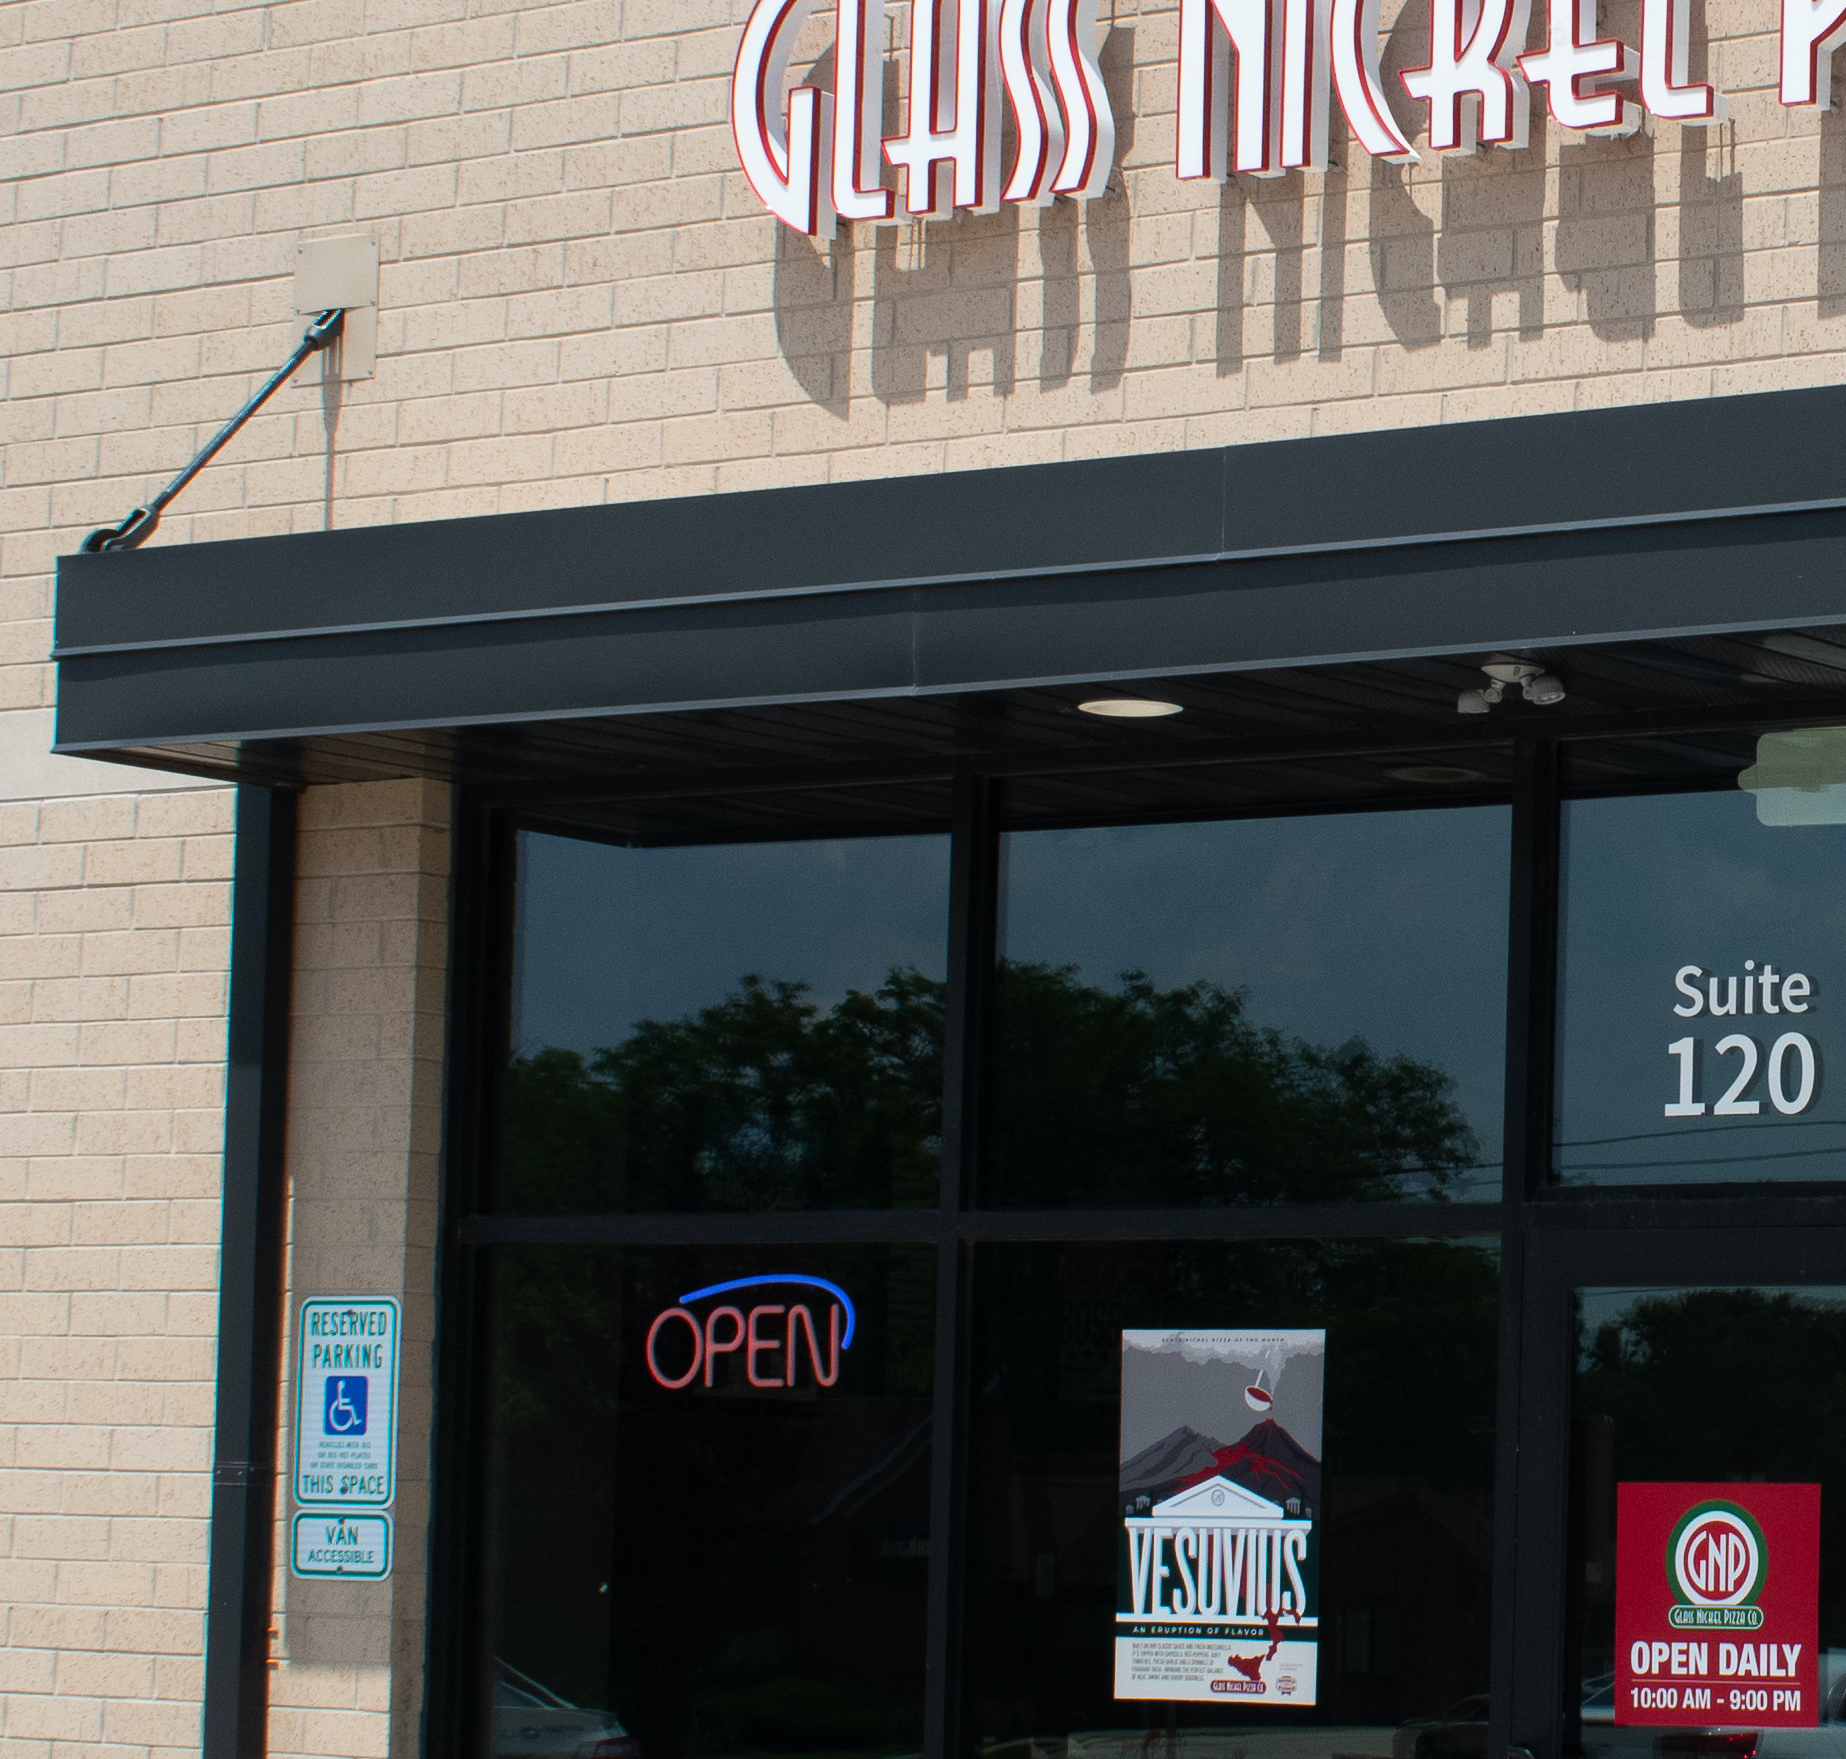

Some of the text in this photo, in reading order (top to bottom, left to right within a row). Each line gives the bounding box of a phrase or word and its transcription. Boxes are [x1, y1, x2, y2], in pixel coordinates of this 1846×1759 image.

[1673, 959, 1811, 1018] Suite
[1664, 1031, 1816, 1117] 120
[311, 1311, 387, 1336] RESERVED
[312, 1344, 383, 1368] PARKING
[645, 1303, 840, 1390] OPEN
[303, 1474, 385, 1494] THIS SPACE
[325, 1526, 359, 1545] VAN
[308, 1549, 375, 1563] ACCESSIBLE
[1687, 1530, 1746, 1592] GNP
[1129, 1527, 1307, 1617] VESUVIUS
[1674, 1608, 1695, 1624] GLASS
[1696, 1608, 1722, 1624] NICKEL
[1724, 1608, 1746, 1625] PIZZA
[1132, 1625, 1265, 1637] AN ERUPTION OF FLAVOR
[1630, 1640, 1802, 1677] OPEN DAILY
[1631, 1687, 1678, 1709] 10:00
[1682, 1688, 1711, 1710] AM
[1729, 1689, 1768, 1711] 9:00
[1772, 1690, 1801, 1712] PM
